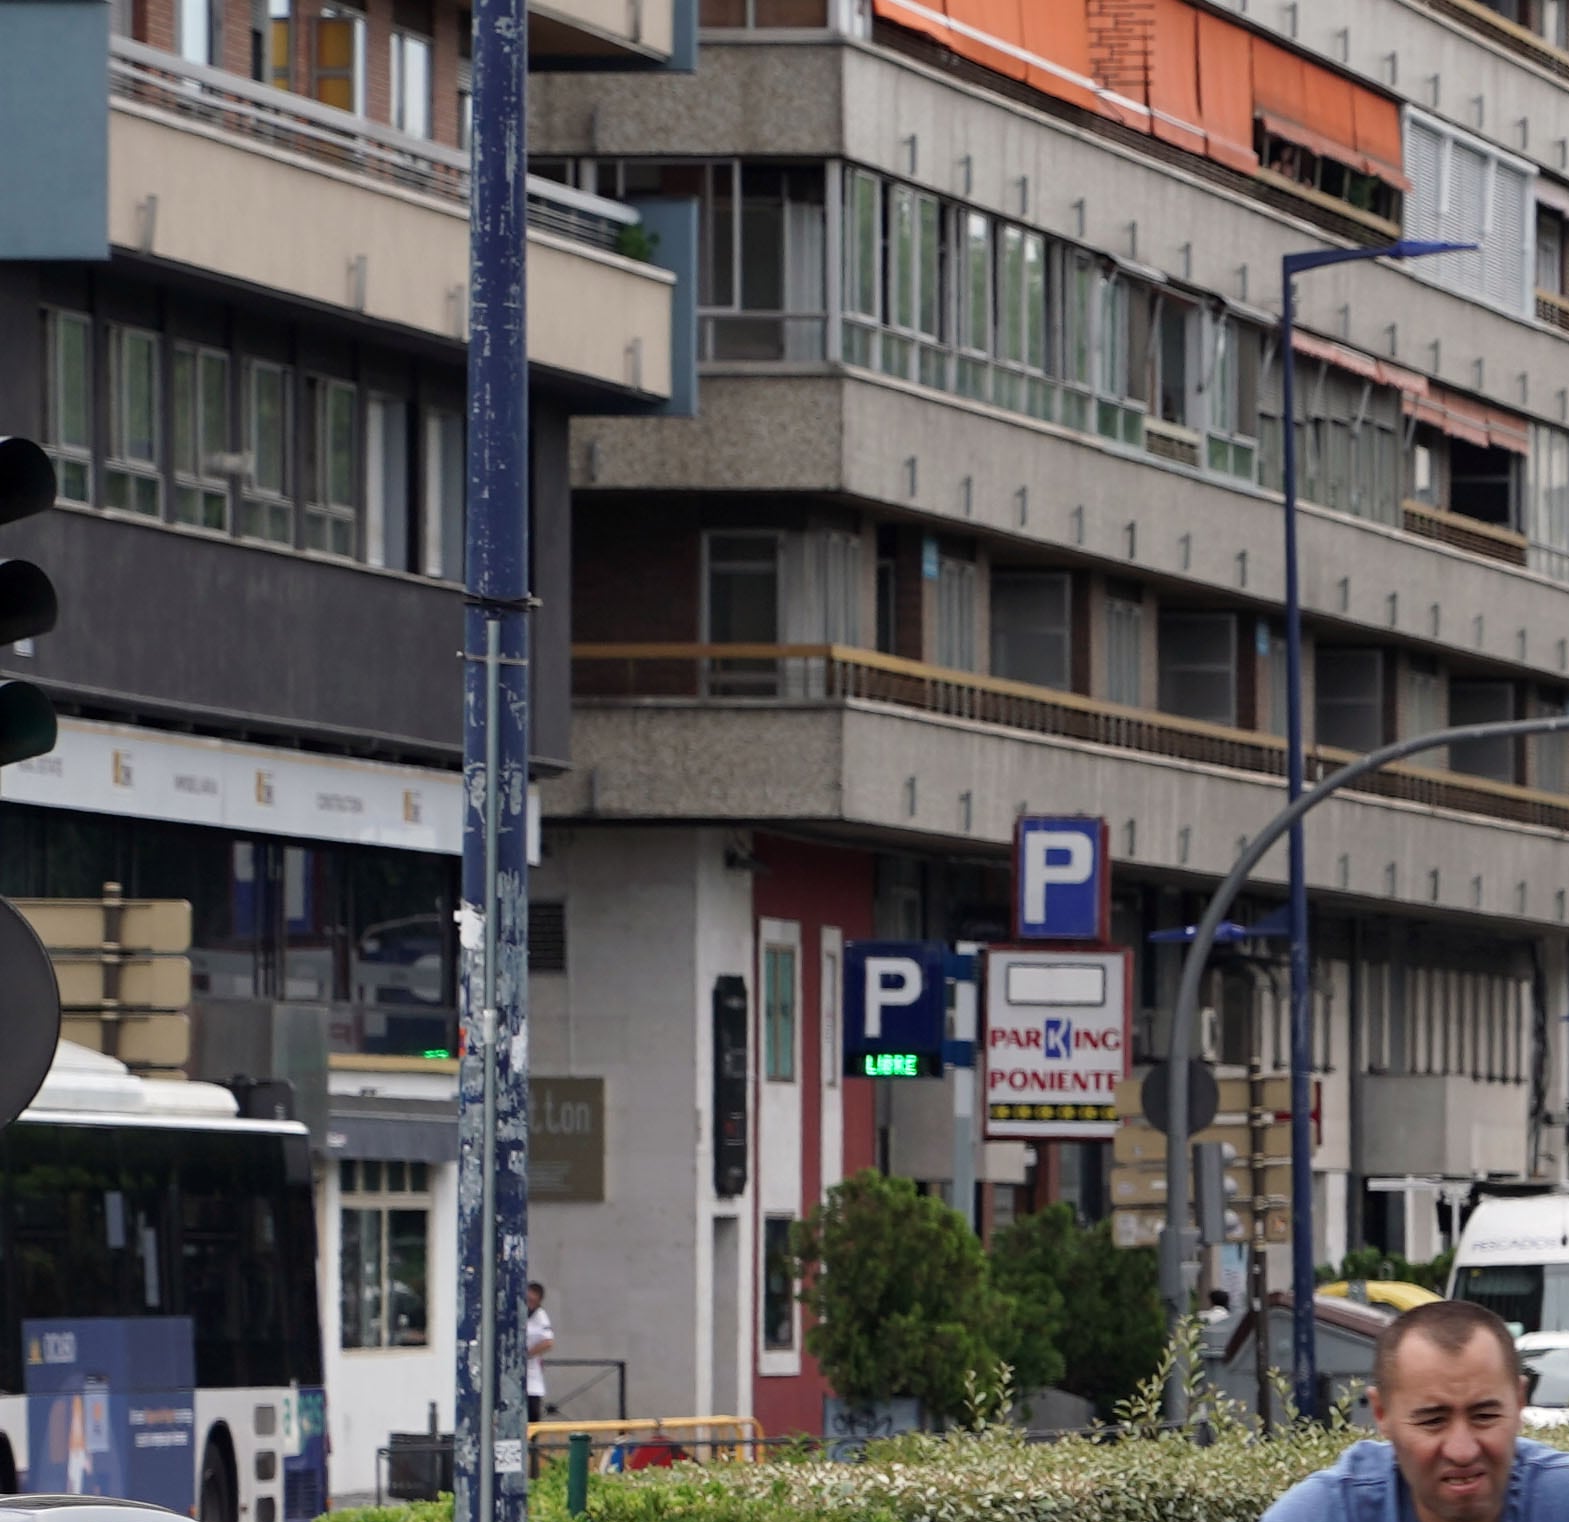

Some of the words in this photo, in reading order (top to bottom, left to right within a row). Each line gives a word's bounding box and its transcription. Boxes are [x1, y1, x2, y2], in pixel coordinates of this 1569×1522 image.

[1023, 831, 1094, 924] P
[864, 956, 922, 1038] P
[990, 1021, 1121, 1057] PARKING
[865, 1054, 918, 1076] LIBRE
[990, 1069, 1119, 1091] PONIENTE
